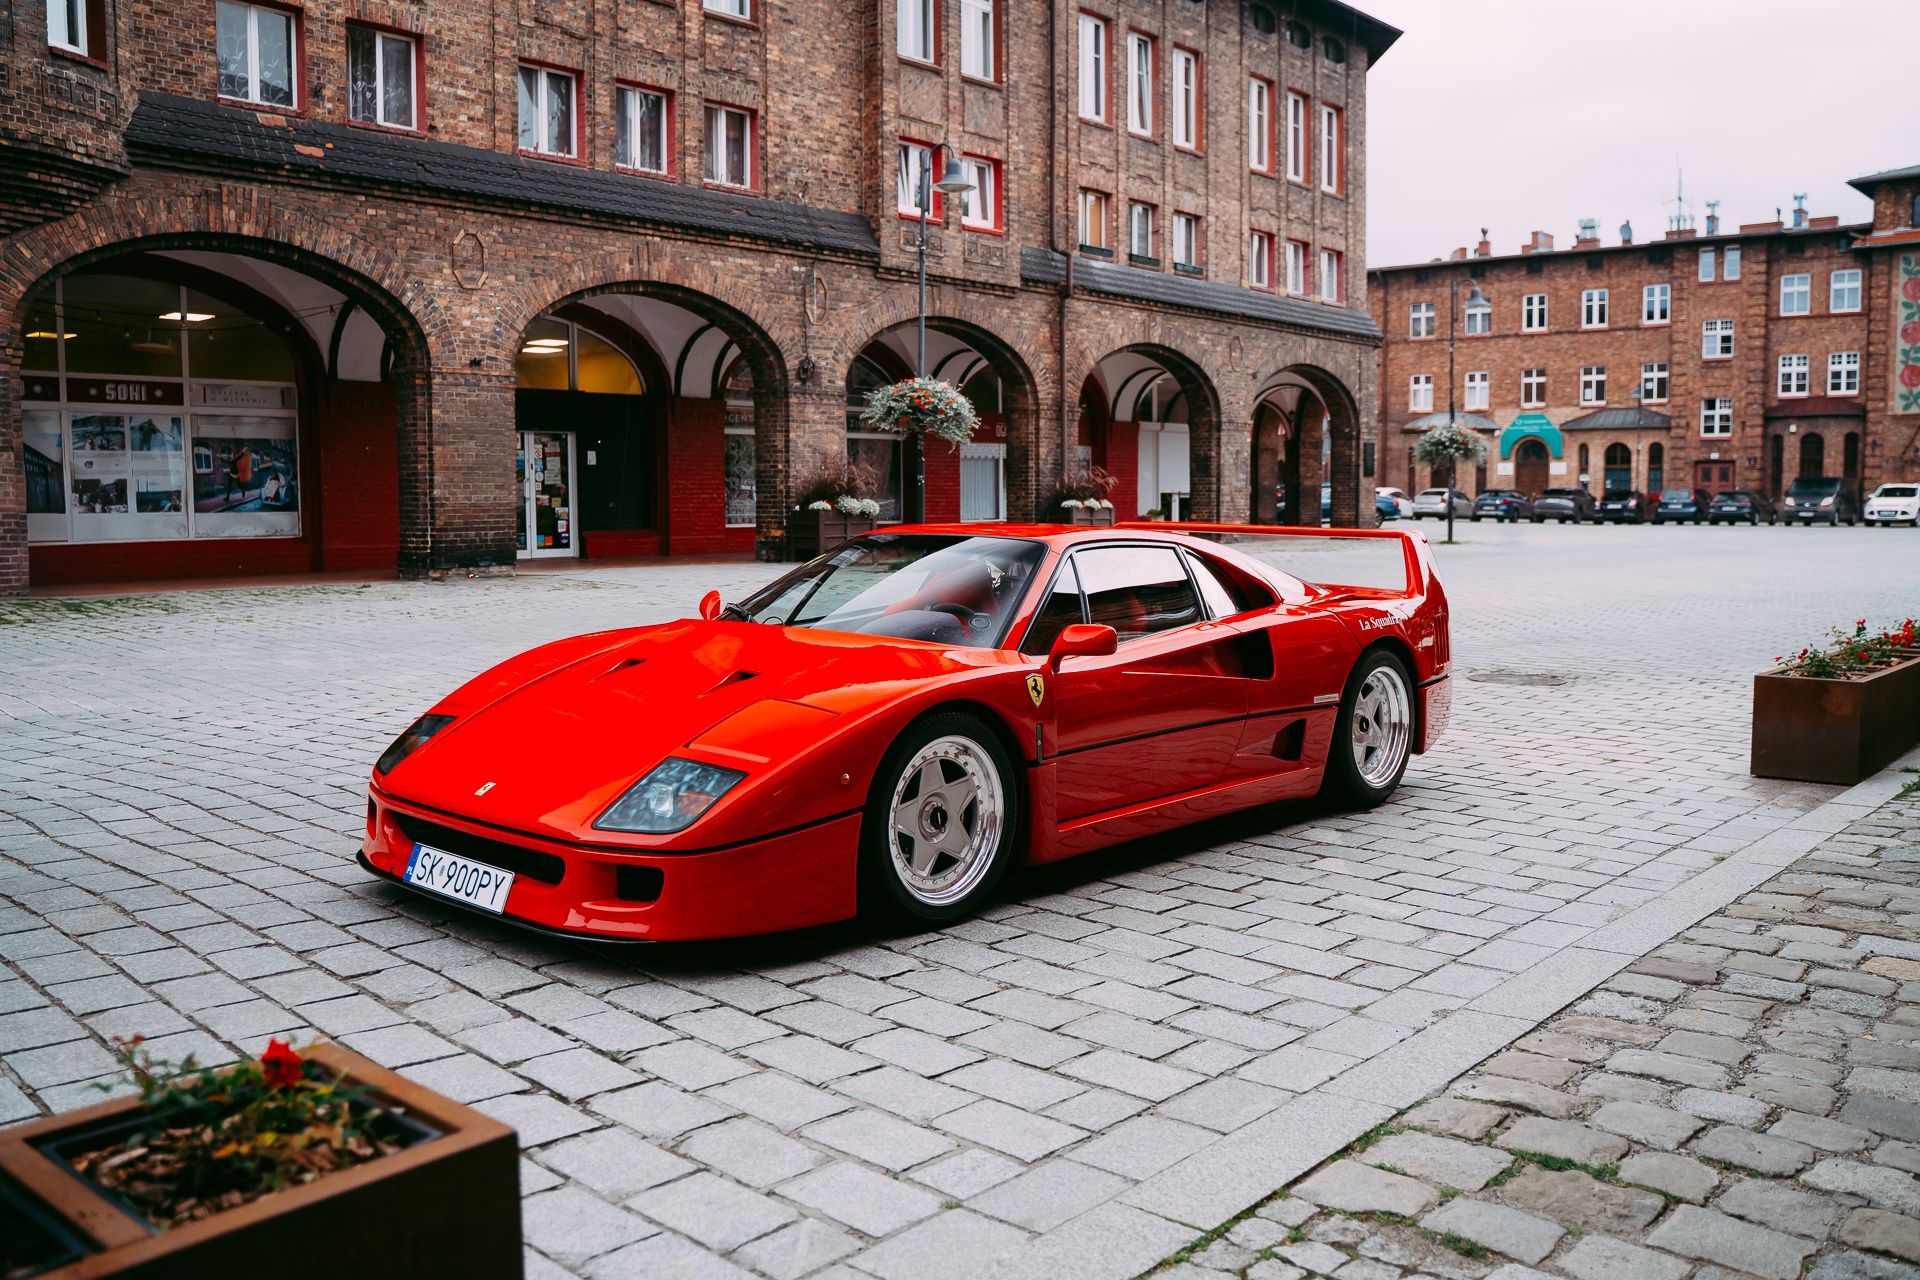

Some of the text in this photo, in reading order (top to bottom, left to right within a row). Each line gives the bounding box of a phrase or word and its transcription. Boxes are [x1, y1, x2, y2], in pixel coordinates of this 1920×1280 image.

[1358, 619, 1372, 631] La
[406, 865, 413, 876] PL
[416, 852, 506, 905] SK 900PY
